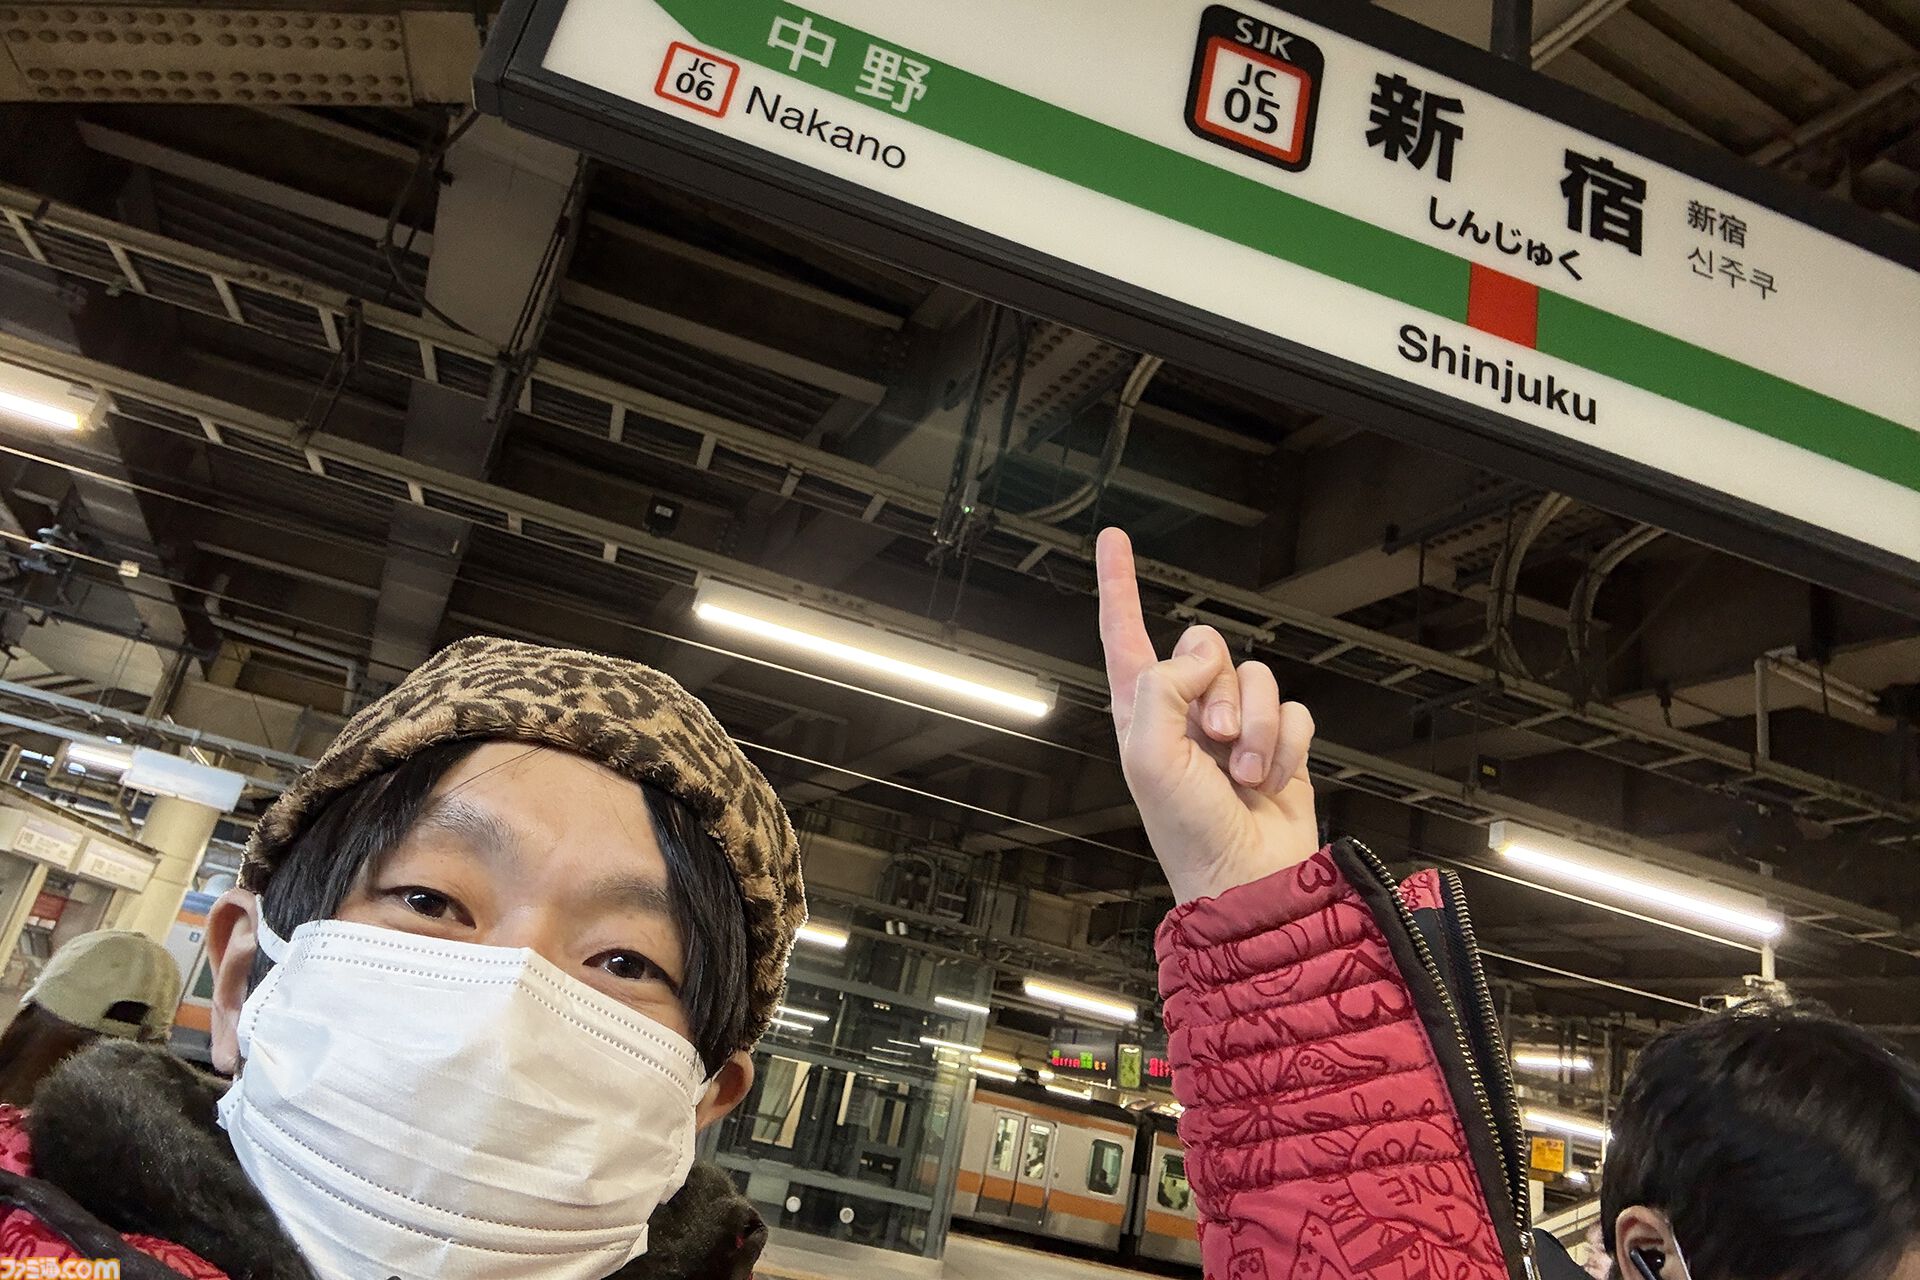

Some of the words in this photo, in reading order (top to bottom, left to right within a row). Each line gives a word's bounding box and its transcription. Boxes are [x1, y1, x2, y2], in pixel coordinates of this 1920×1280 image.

[767, 16, 931, 114] 中野
[1234, 18, 1292, 61] SJK
[675, 72, 715, 101] 06
[688, 58, 716, 78] JC
[1237, 63, 1277, 97] JC
[745, 86, 906, 169] Nakano
[1224, 87, 1281, 134] 05
[1365, 72, 1647, 257] 新宿
[1428, 195, 1583, 281] しんじゅく
[1687, 200, 1748, 248] 新宿
[1687, 245, 1778, 300] 신주쿠
[1397, 324, 1597, 425] Shinjuku
